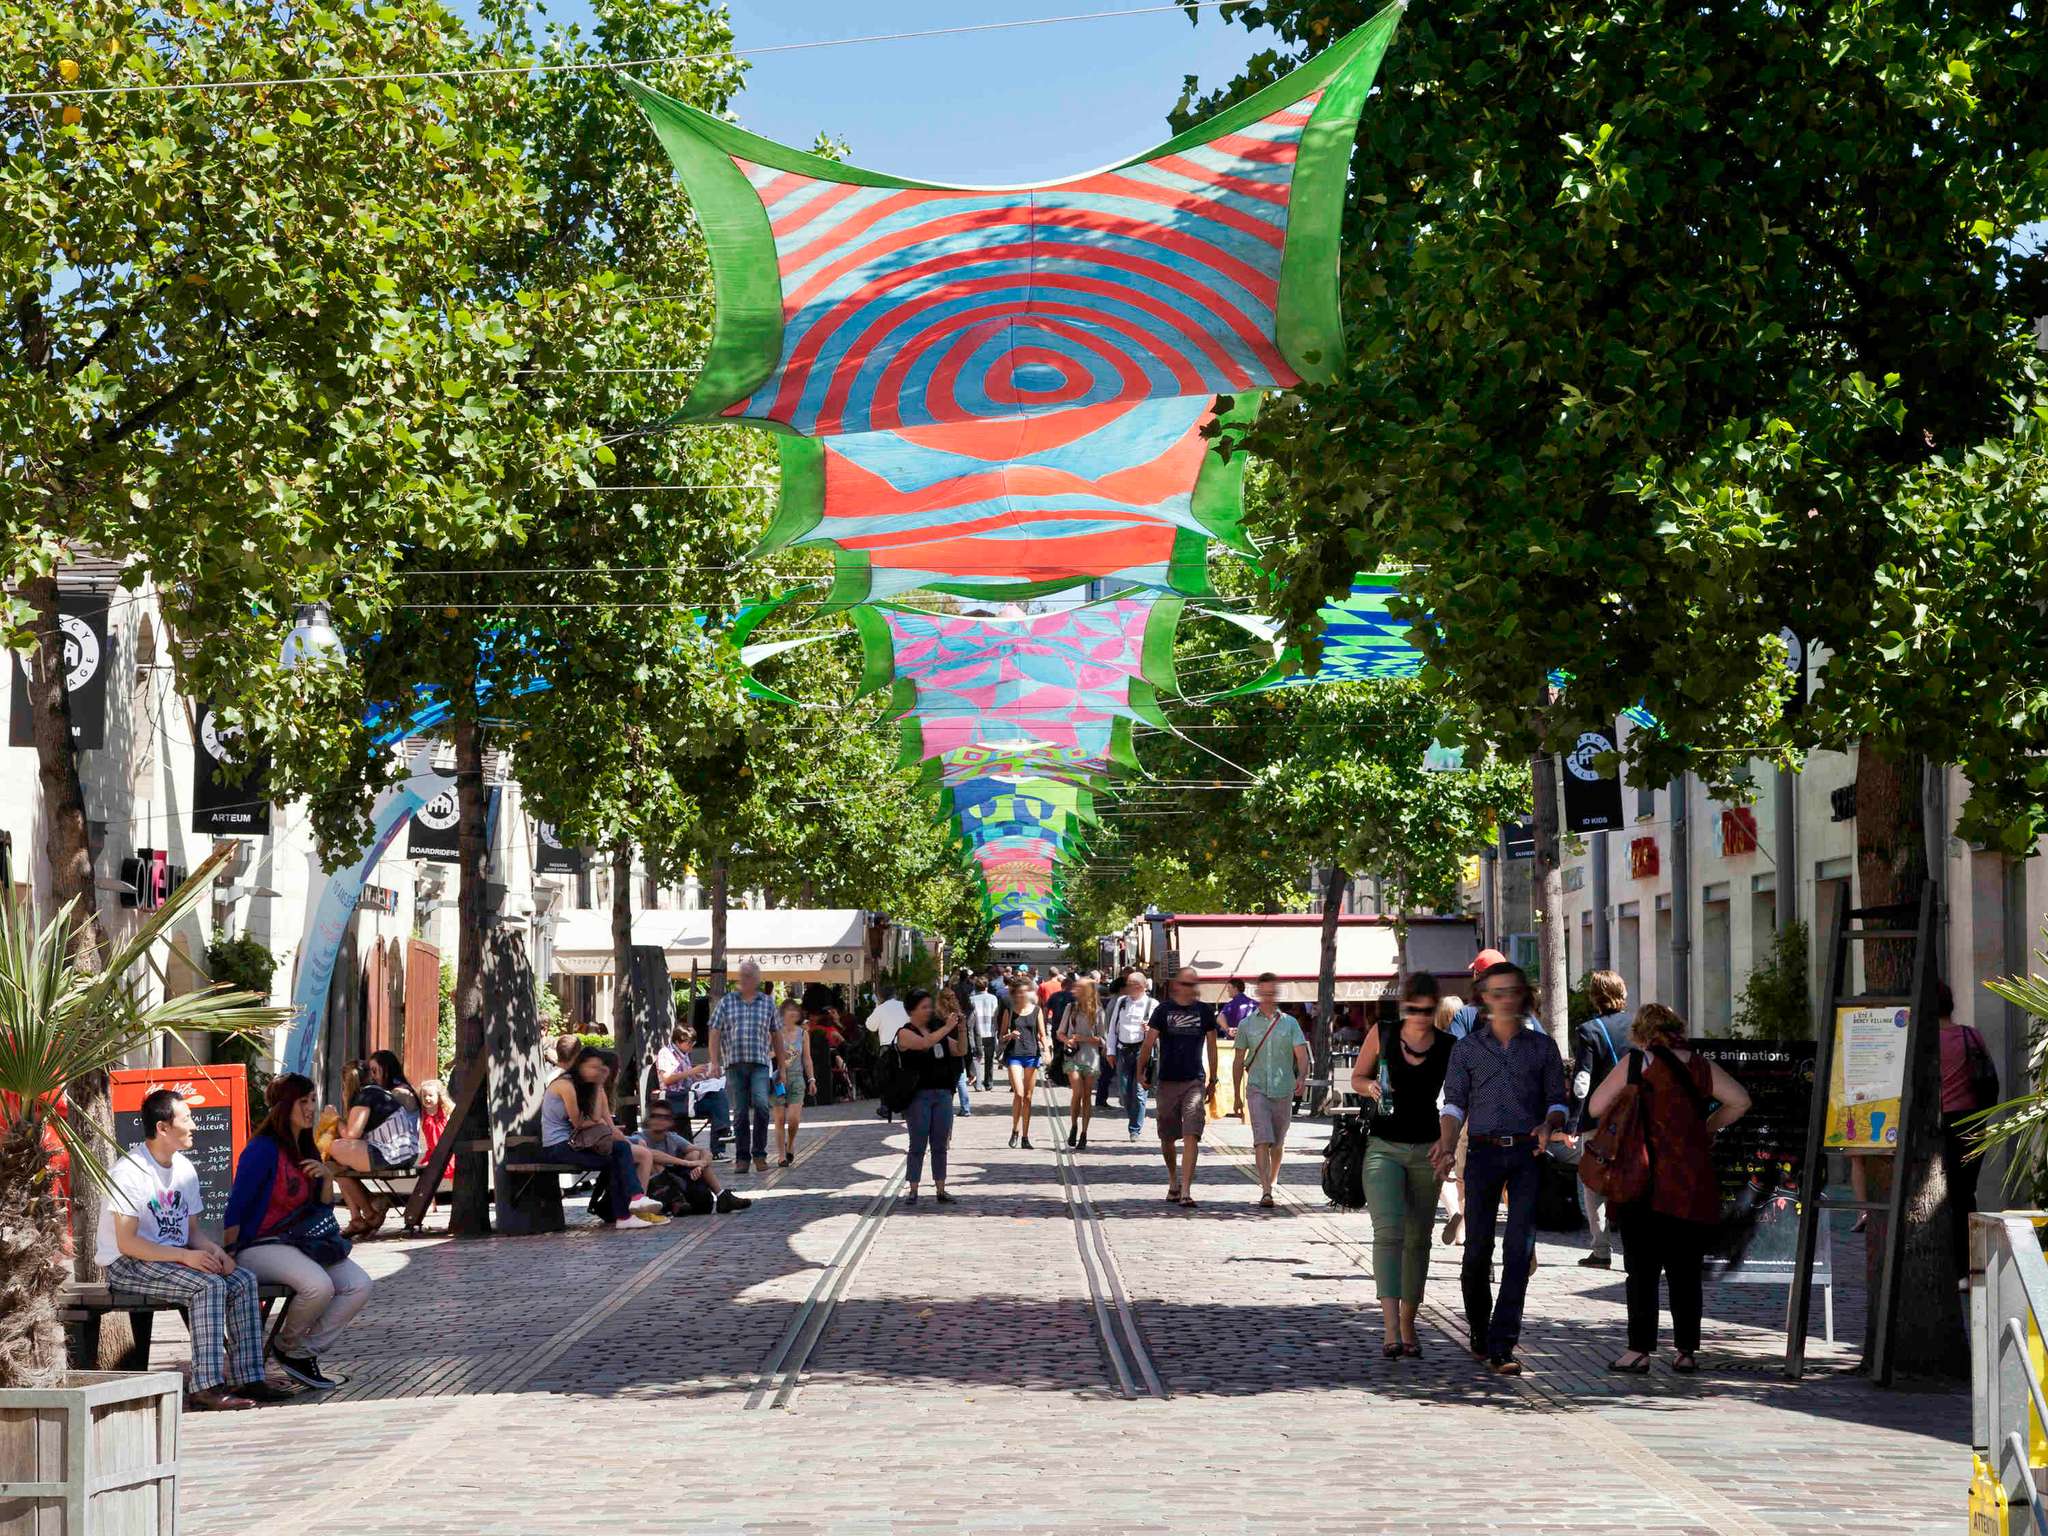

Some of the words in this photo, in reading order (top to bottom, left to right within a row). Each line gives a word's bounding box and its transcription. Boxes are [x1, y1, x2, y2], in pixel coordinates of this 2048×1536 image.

[211, 813, 252, 823] ARTEUM
[410, 846, 460, 857] BOARDRIDERS
[1720, 1050, 1790, 1062] animations
